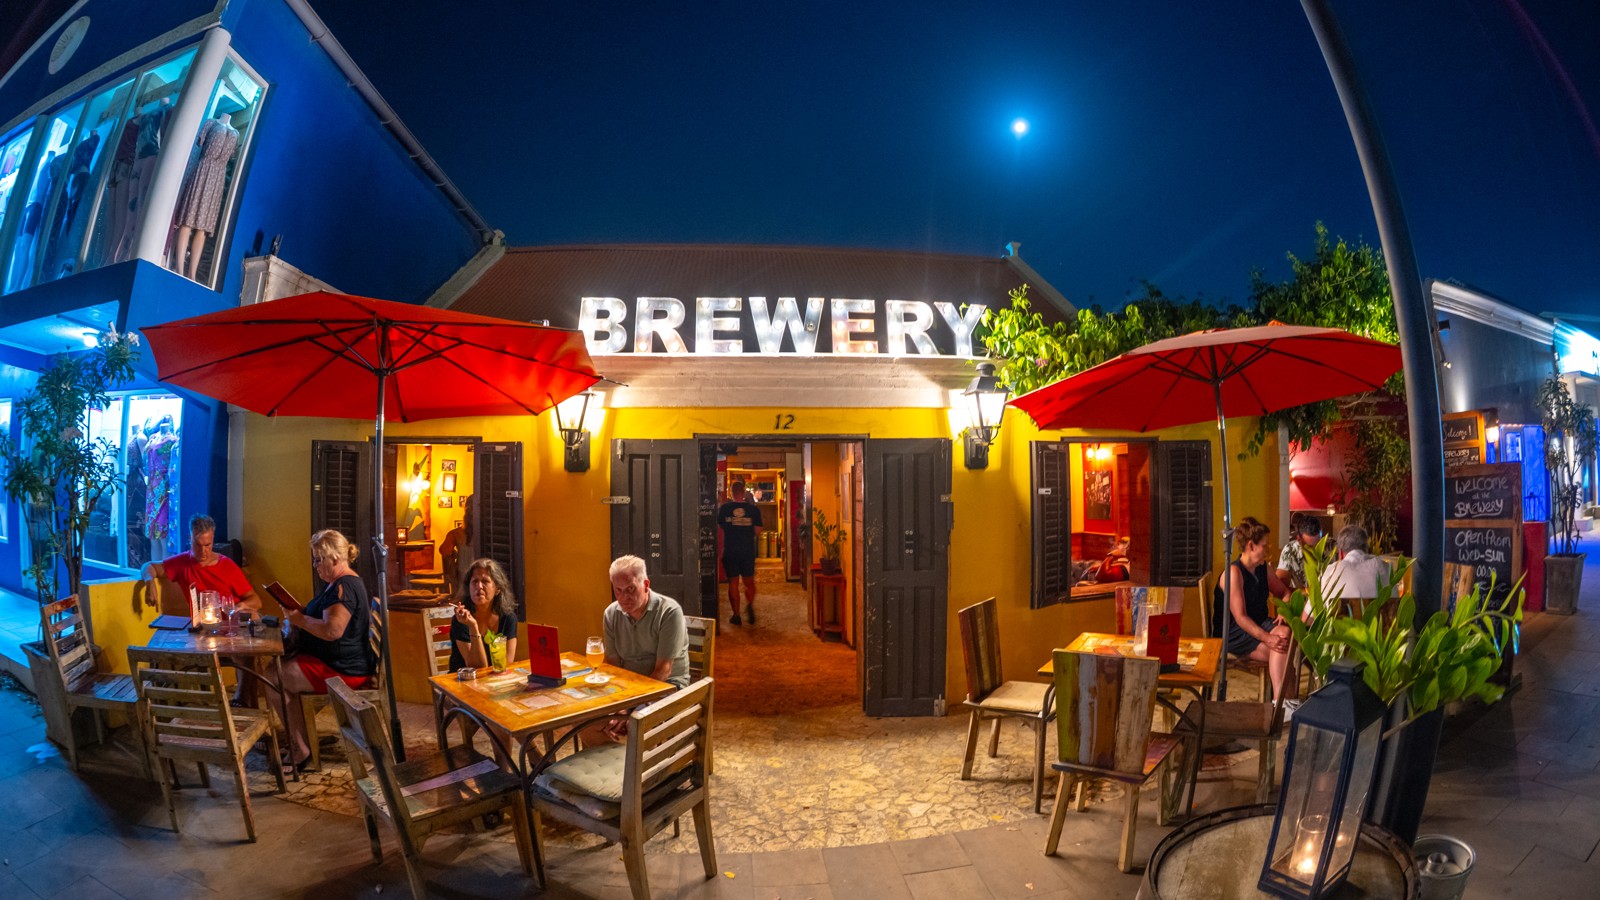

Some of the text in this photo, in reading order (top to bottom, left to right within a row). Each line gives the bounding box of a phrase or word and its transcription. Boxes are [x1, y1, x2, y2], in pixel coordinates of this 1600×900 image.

[578, 296, 987, 356] BREWERY
[775, 414, 795, 430] 12
[1455, 476, 1508, 495] Welcome
[1455, 529, 1485, 547] Open
